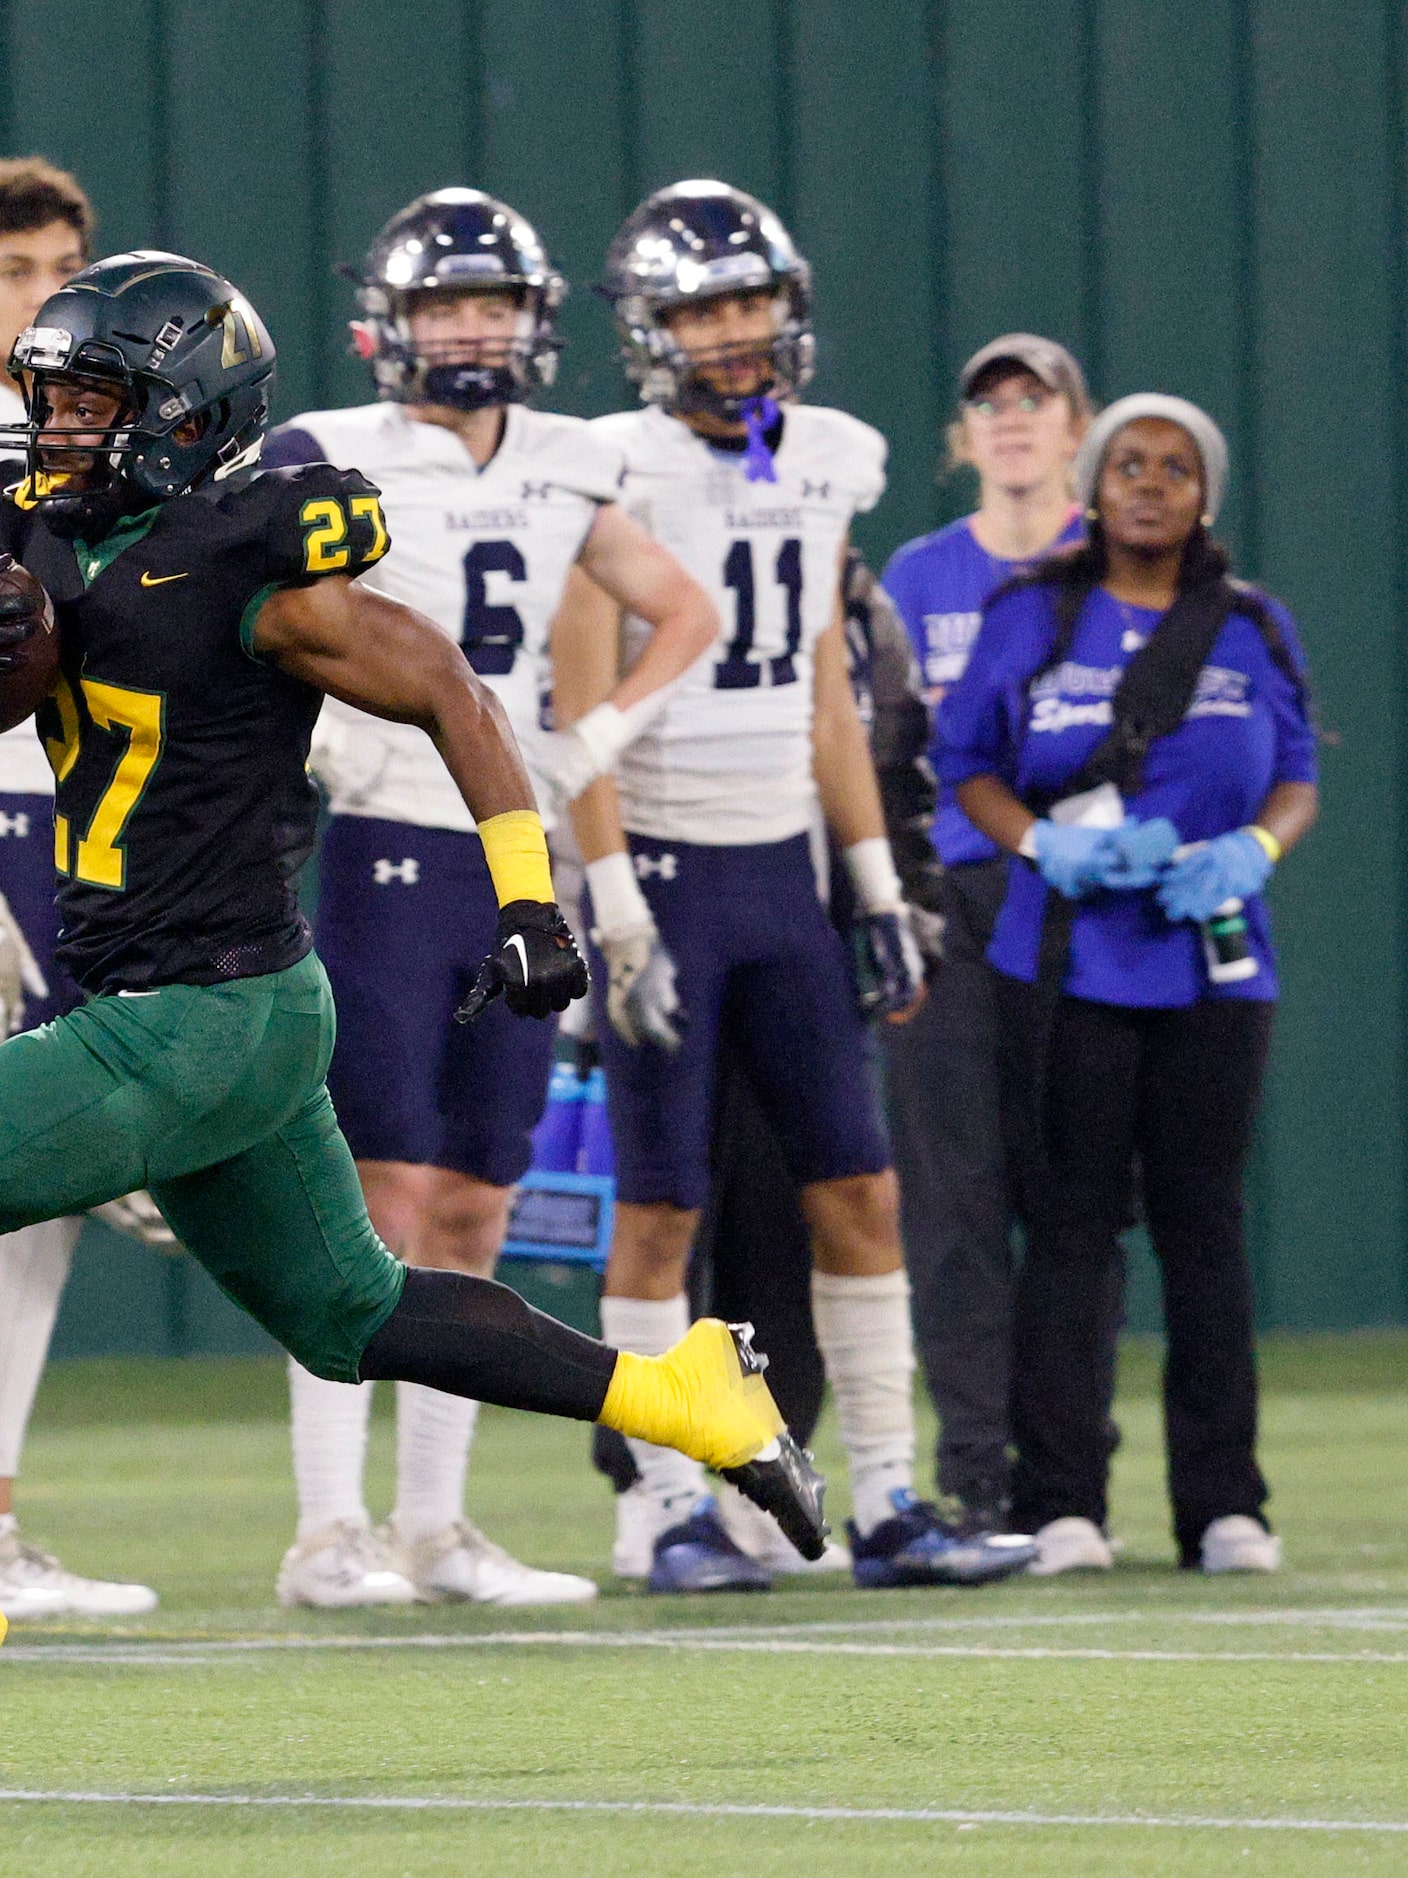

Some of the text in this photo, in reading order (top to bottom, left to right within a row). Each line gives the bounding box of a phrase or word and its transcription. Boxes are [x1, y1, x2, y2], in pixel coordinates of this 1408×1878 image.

[298, 495, 390, 574] 27
[461, 539, 528, 675] 6
[714, 538, 803, 689] 11
